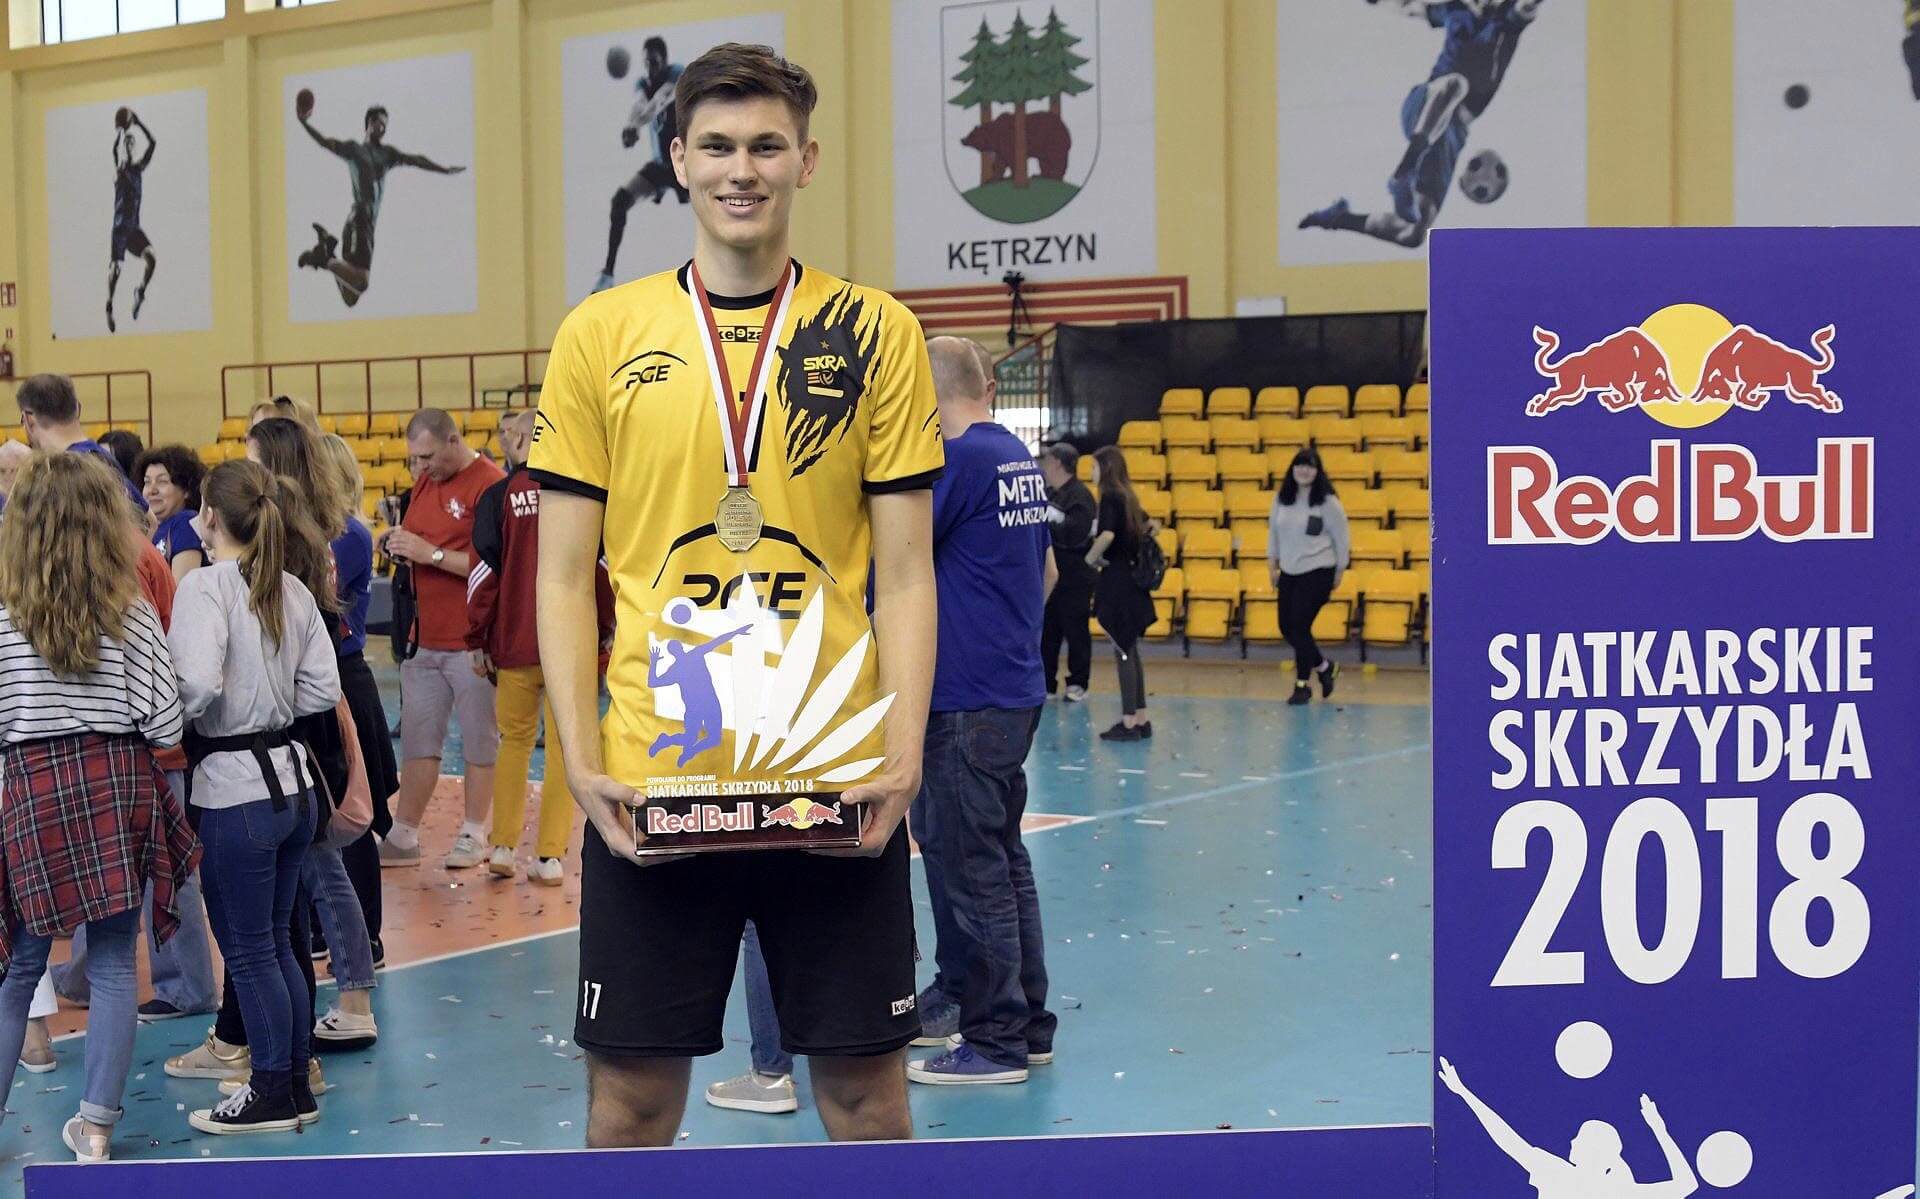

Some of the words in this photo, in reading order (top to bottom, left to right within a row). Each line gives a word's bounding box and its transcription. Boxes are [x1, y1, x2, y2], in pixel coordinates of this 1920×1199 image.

[948, 233, 1096, 275] KĘTRZYN
[626, 364, 669, 389] PGE
[803, 355, 847, 371] SKRA
[1488, 439, 1681, 544] Red
[1691, 437, 1874, 543] Bull
[1488, 627, 1873, 700] SIATKARSKIE
[1488, 703, 1872, 790] SKRZYDŁA
[647, 782, 719, 799] SIATKARSKIE
[721, 780, 781, 796] SKRZYDŁA
[784, 779, 813, 793] 2018
[647, 804, 701, 834] Red
[702, 802, 754, 832] Bull
[1490, 792, 1871, 987] 2018
[583, 980, 602, 1019] 17
